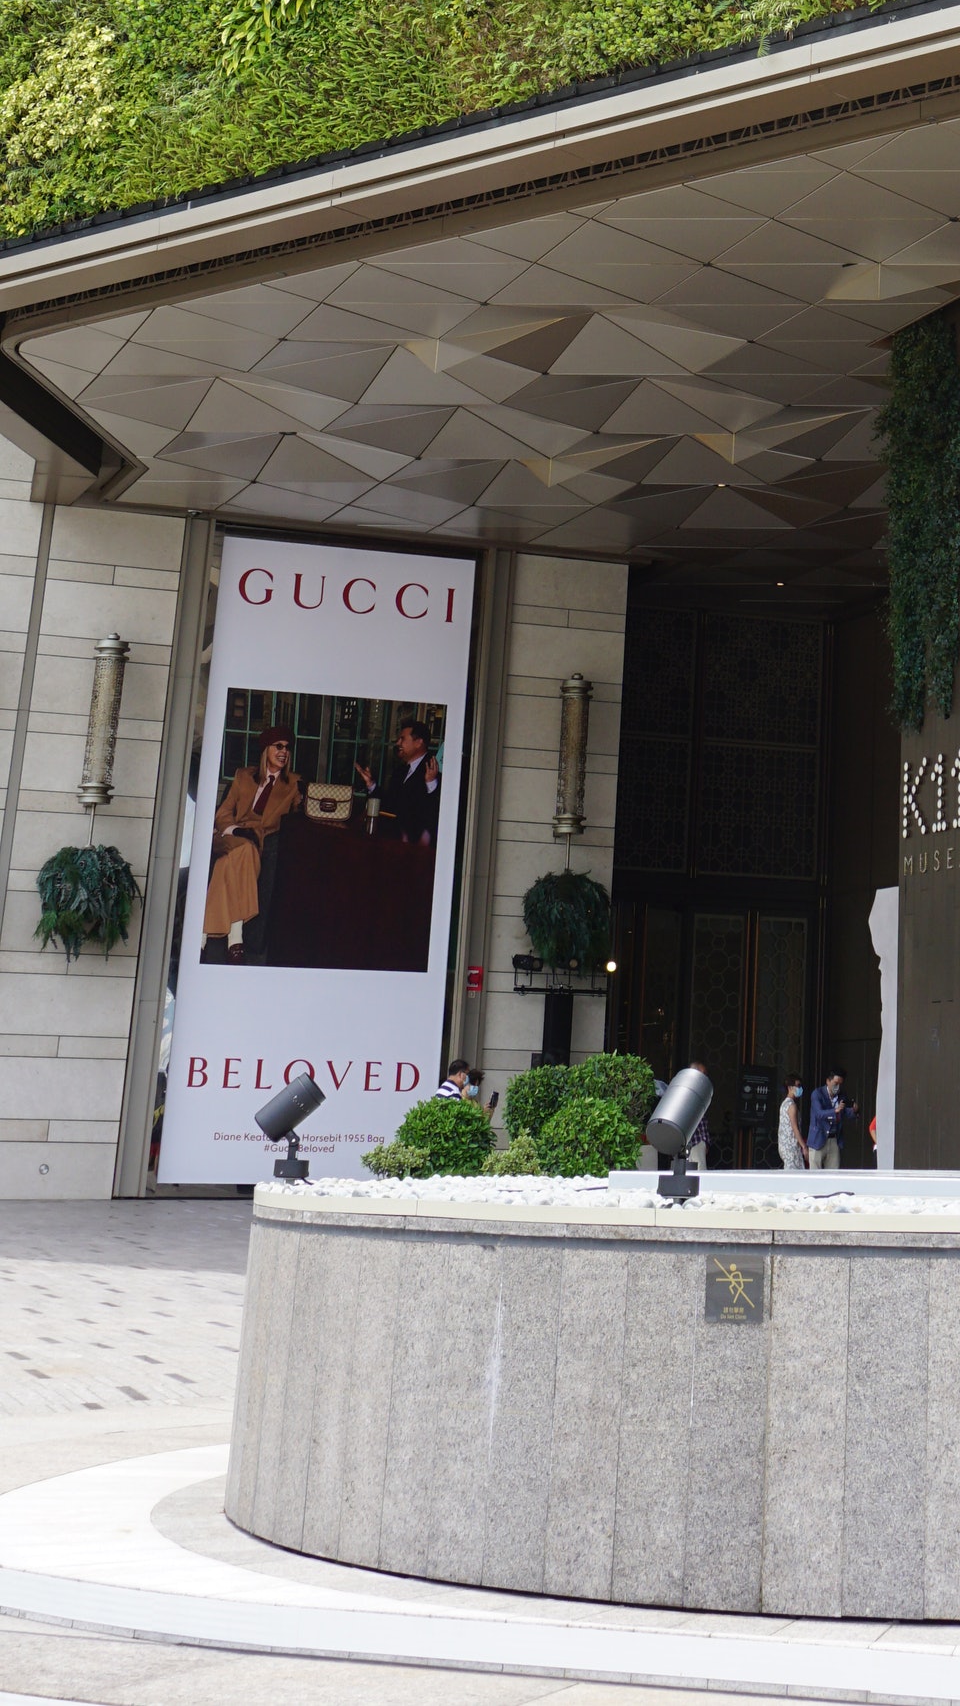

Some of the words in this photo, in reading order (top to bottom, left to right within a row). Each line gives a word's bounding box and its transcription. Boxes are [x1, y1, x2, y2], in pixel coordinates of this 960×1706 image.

[238, 568, 456, 623] GUCCI
[186, 1056, 421, 1092] BELOVED
[213, 1132, 242, 1141] Diane
[302, 1133, 342, 1143] Horsebit
[344, 1134, 365, 1143] 1955
[367, 1134, 385, 1144] Bag
